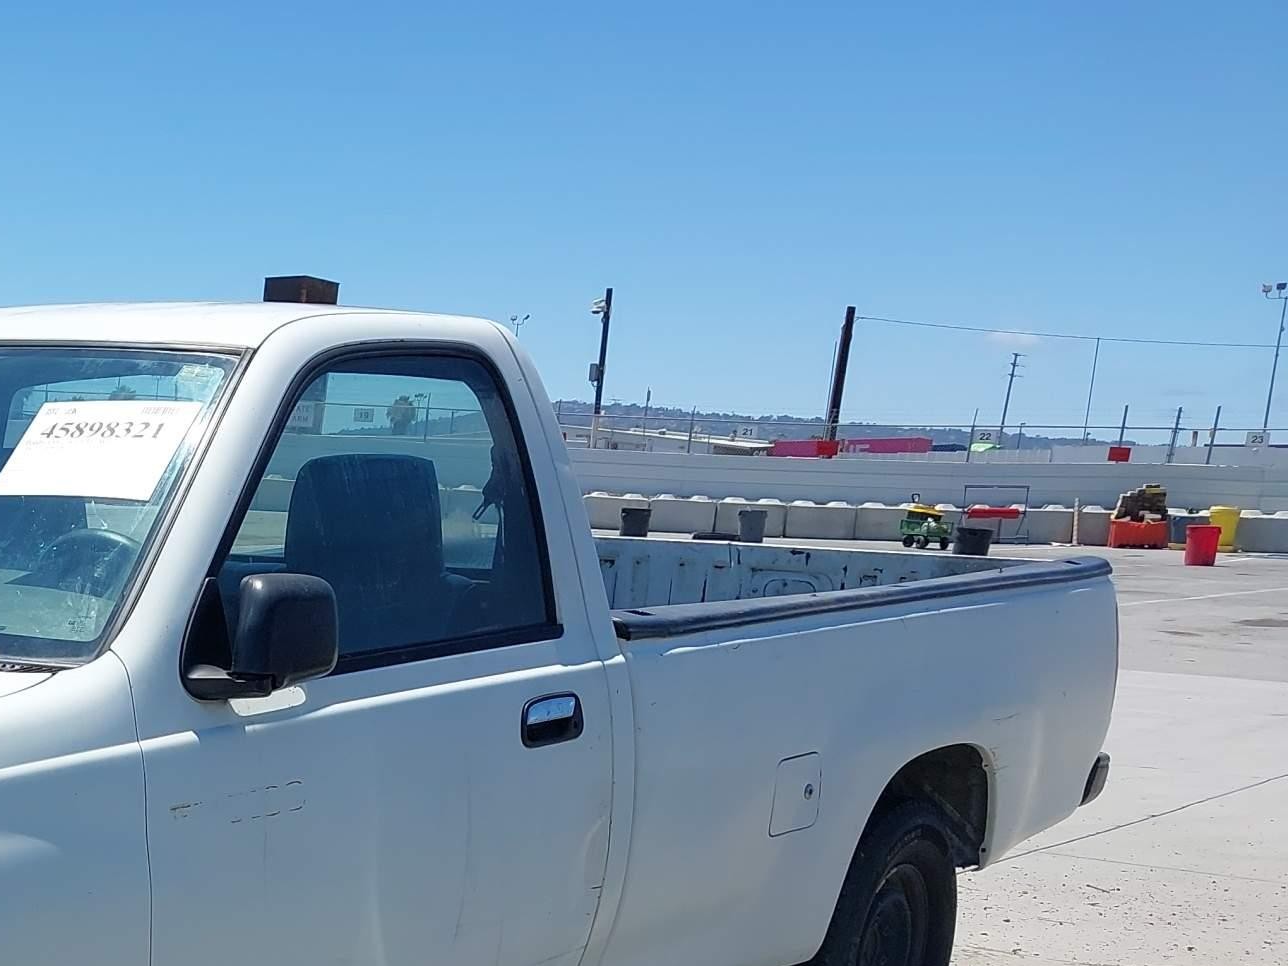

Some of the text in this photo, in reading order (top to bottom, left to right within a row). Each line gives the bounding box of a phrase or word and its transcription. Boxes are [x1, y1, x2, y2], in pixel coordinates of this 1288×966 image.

[40, 416, 165, 439] 45898321
[742, 428, 753, 436] 21
[979, 432, 992, 441] 22
[1251, 435, 1264, 444] 23
